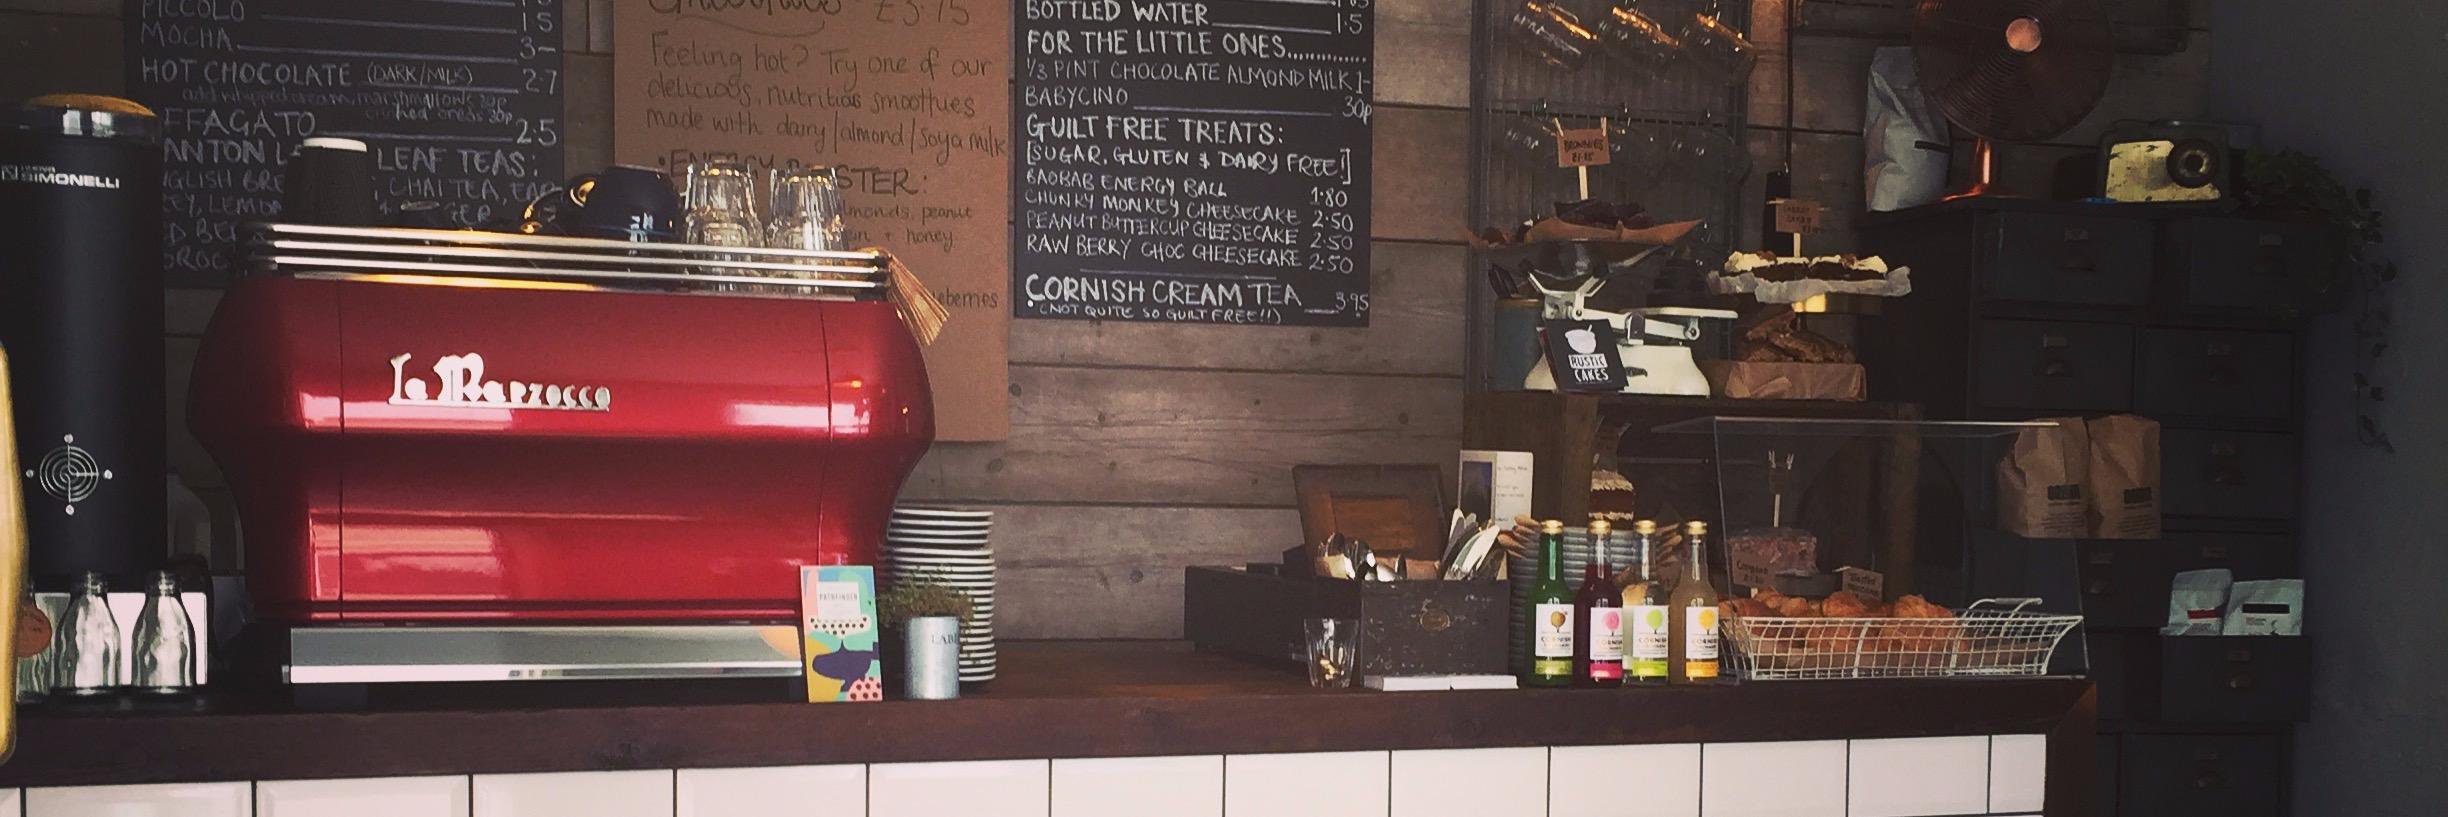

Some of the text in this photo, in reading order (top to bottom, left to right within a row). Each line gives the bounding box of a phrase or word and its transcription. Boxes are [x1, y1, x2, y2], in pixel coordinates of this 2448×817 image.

[1026, 0, 1121, 22] BOTTLED
[1131, 1, 1208, 27] WATER
[1027, 29, 1073, 55] FOR
[1080, 30, 1128, 55] THE
[1136, 29, 1213, 55] LITTLE
[142, 58, 197, 83] HOT
[203, 60, 352, 87] CHOCOLATE
[367, 61, 473, 86] (DARK/MILK)
[650, 29, 992, 92] Feeling hot? Try one of our
[1055, 60, 1100, 80] PINT
[1110, 60, 1220, 82] CHOCOLATE
[1228, 64, 1304, 88] ALMOND
[1308, 68, 1352, 92] MILK
[1025, 85, 1128, 109] BABYCINO
[163, 108, 316, 138] FFAGATO
[645, 105, 704, 131] made
[712, 110, 763, 137] with
[1026, 113, 1284, 146] GUILT FREE TREATS:
[164, 137, 265, 165] ANTON
[377, 147, 447, 174] LEAF
[1113, 146, 1189, 166] GLUTEN
[1218, 151, 1278, 174] DAIRY
[389, 176, 443, 198] CHAI
[1026, 168, 1095, 191] BAOBAB
[1101, 174, 1175, 197] ENERGY
[1184, 177, 1227, 198] BALL
[921, 205, 977, 226] peanut
[1025, 189, 1095, 211] CHUNKY
[1103, 194, 1179, 219] MONKEY
[1187, 201, 1299, 226] CHEESECAKE
[907, 227, 953, 254] honey
[1026, 209, 1098, 232] PEANUT
[1102, 212, 1191, 238] BUTTERCUP
[1193, 220, 1299, 246] CHEESECAKE
[1026, 232, 1071, 256] RAW
[1076, 233, 1133, 261] BERRY
[1141, 241, 1186, 263] CHOC
[1192, 243, 1302, 268] CHEESECAKE
[1025, 273, 1146, 304] CORNISH
[1152, 279, 1243, 307] CREAM
[1248, 283, 1303, 307] TEA
[1084, 305, 1136, 320] QUITE
[1142, 308, 1161, 320] SO
[1167, 307, 1209, 322] GUILT
[1571, 355, 1605, 368] RUSTIC
[1574, 367, 1610, 383] CAKES
